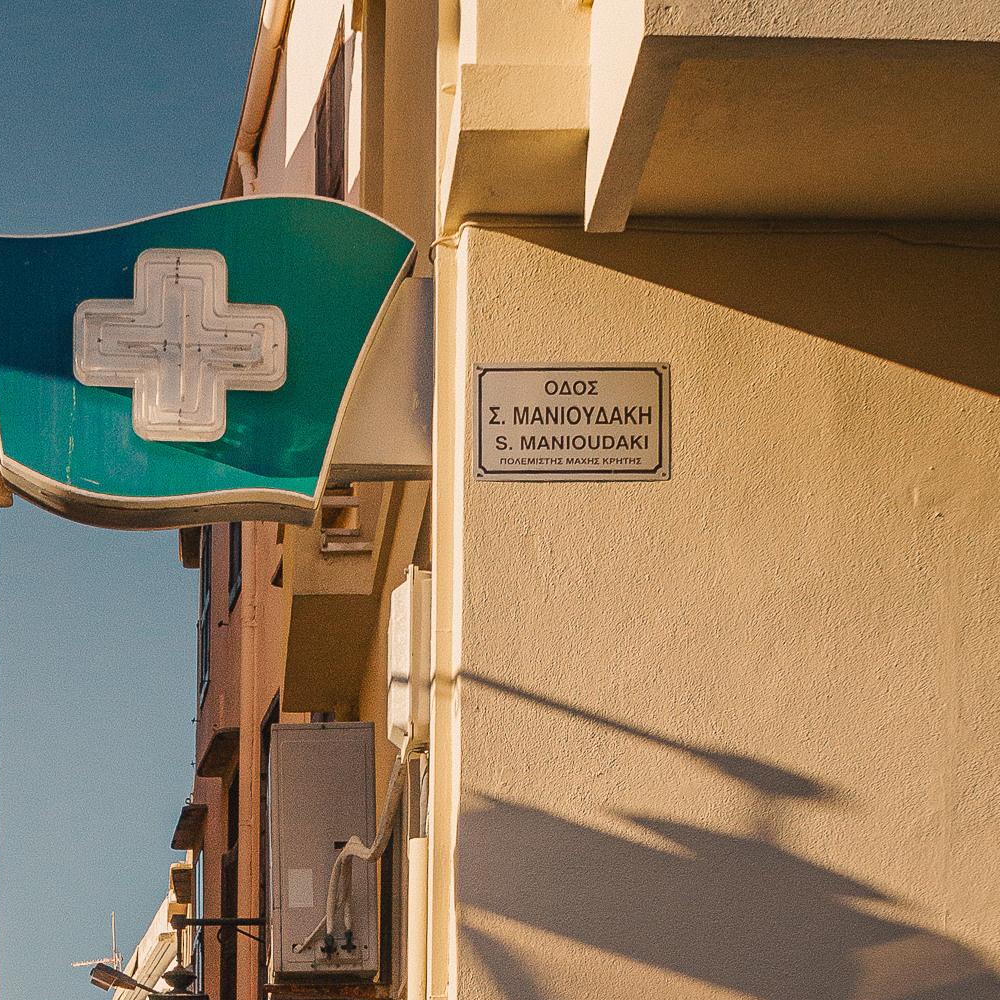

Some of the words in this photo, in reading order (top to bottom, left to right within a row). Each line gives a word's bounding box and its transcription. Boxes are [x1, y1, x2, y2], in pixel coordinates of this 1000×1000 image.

[544, 380, 599, 396] ΟΔΟΣ
[488, 406, 506, 425] Σ.
[513, 405, 652, 425] ΜΑΝΙΟΥΔΑΚΗ
[495, 435, 513, 450] S.
[520, 434, 649, 451] MANIOUDAKI
[500, 457, 563, 466] ΠΟΛΕΜΙΣΤΗΣ
[565, 457, 600, 465] ΜΑΧΗΣ
[602, 457, 642, 465] ΚΡΗΤΗΣ
